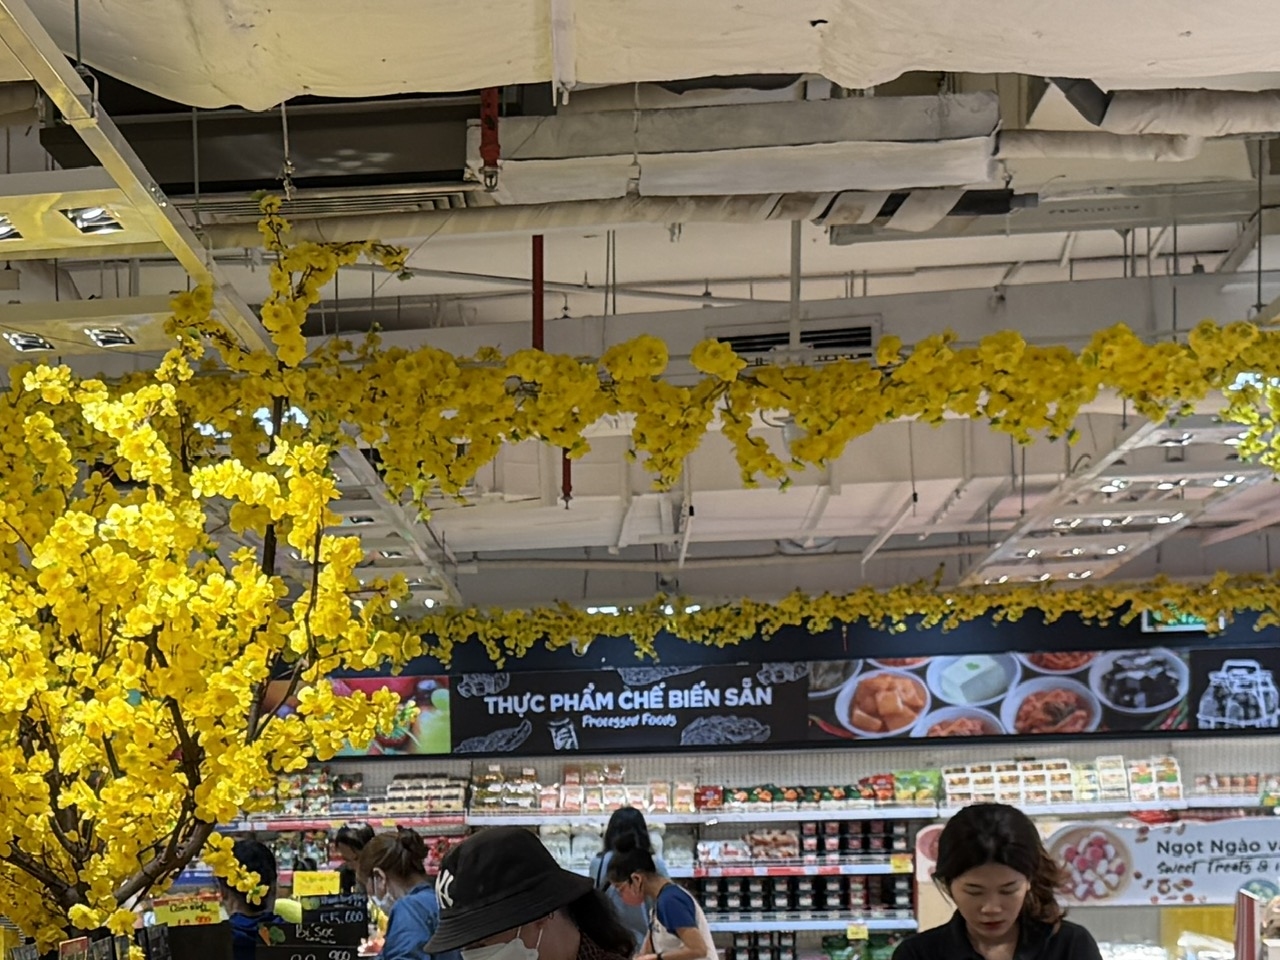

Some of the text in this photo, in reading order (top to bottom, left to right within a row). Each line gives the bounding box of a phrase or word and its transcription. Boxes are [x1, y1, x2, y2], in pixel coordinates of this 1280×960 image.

[484, 677, 772, 718] THỰC PHẨM CHẾ BIẾN SẴN
[1156, 840, 1204, 858] Ngọt
[1210, 838, 1261, 856] Ngào
